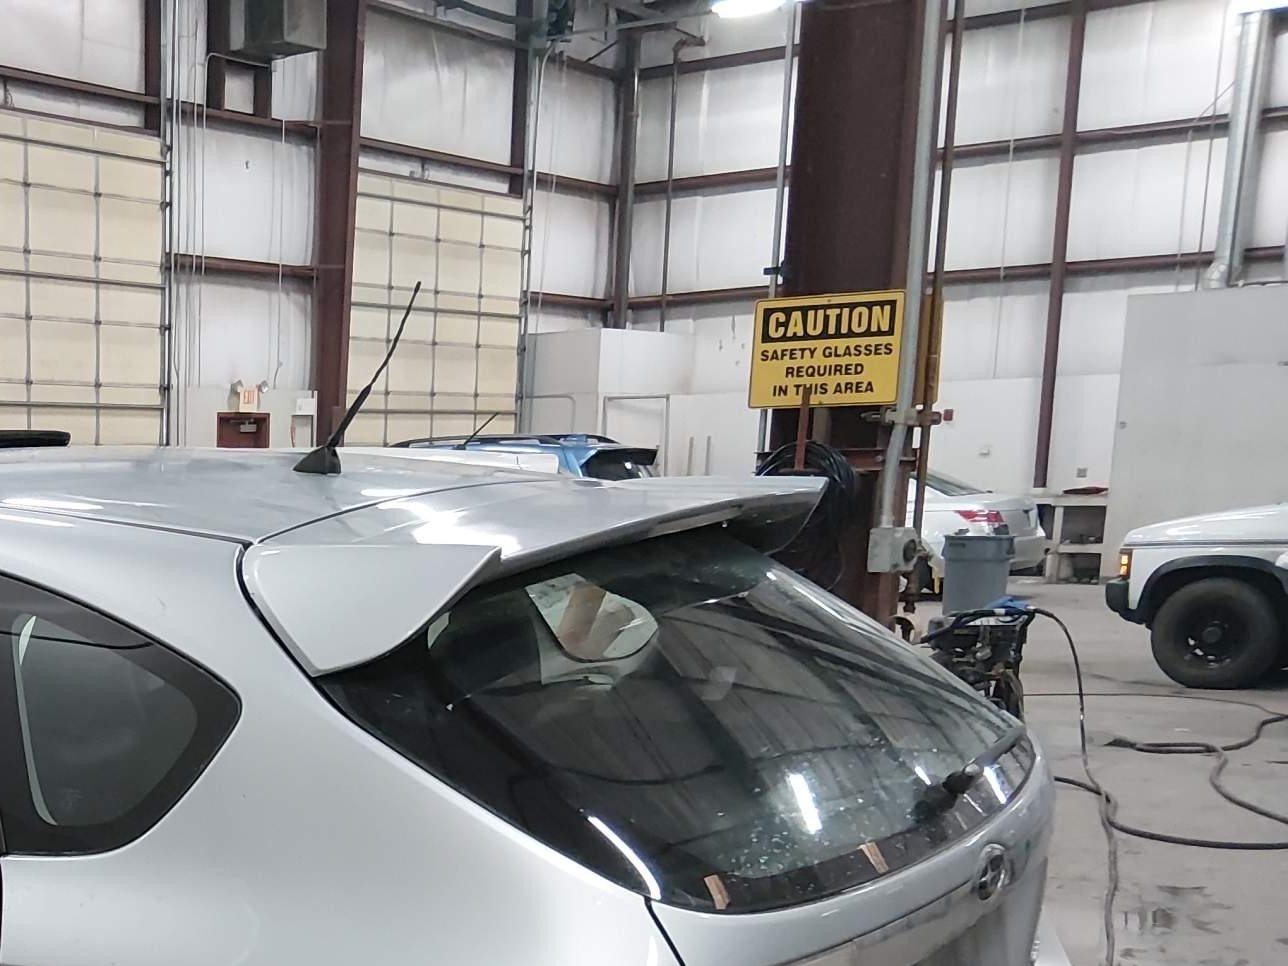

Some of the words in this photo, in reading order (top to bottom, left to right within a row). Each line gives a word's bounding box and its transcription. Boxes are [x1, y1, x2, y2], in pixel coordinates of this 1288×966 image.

[768, 304, 891, 339] CAUTION
[760, 347, 818, 362] SAFETY
[822, 342, 893, 358] GLASSES
[785, 363, 864, 378] REQUIRED
[772, 384, 788, 397] IN
[832, 381, 874, 395] AREA
